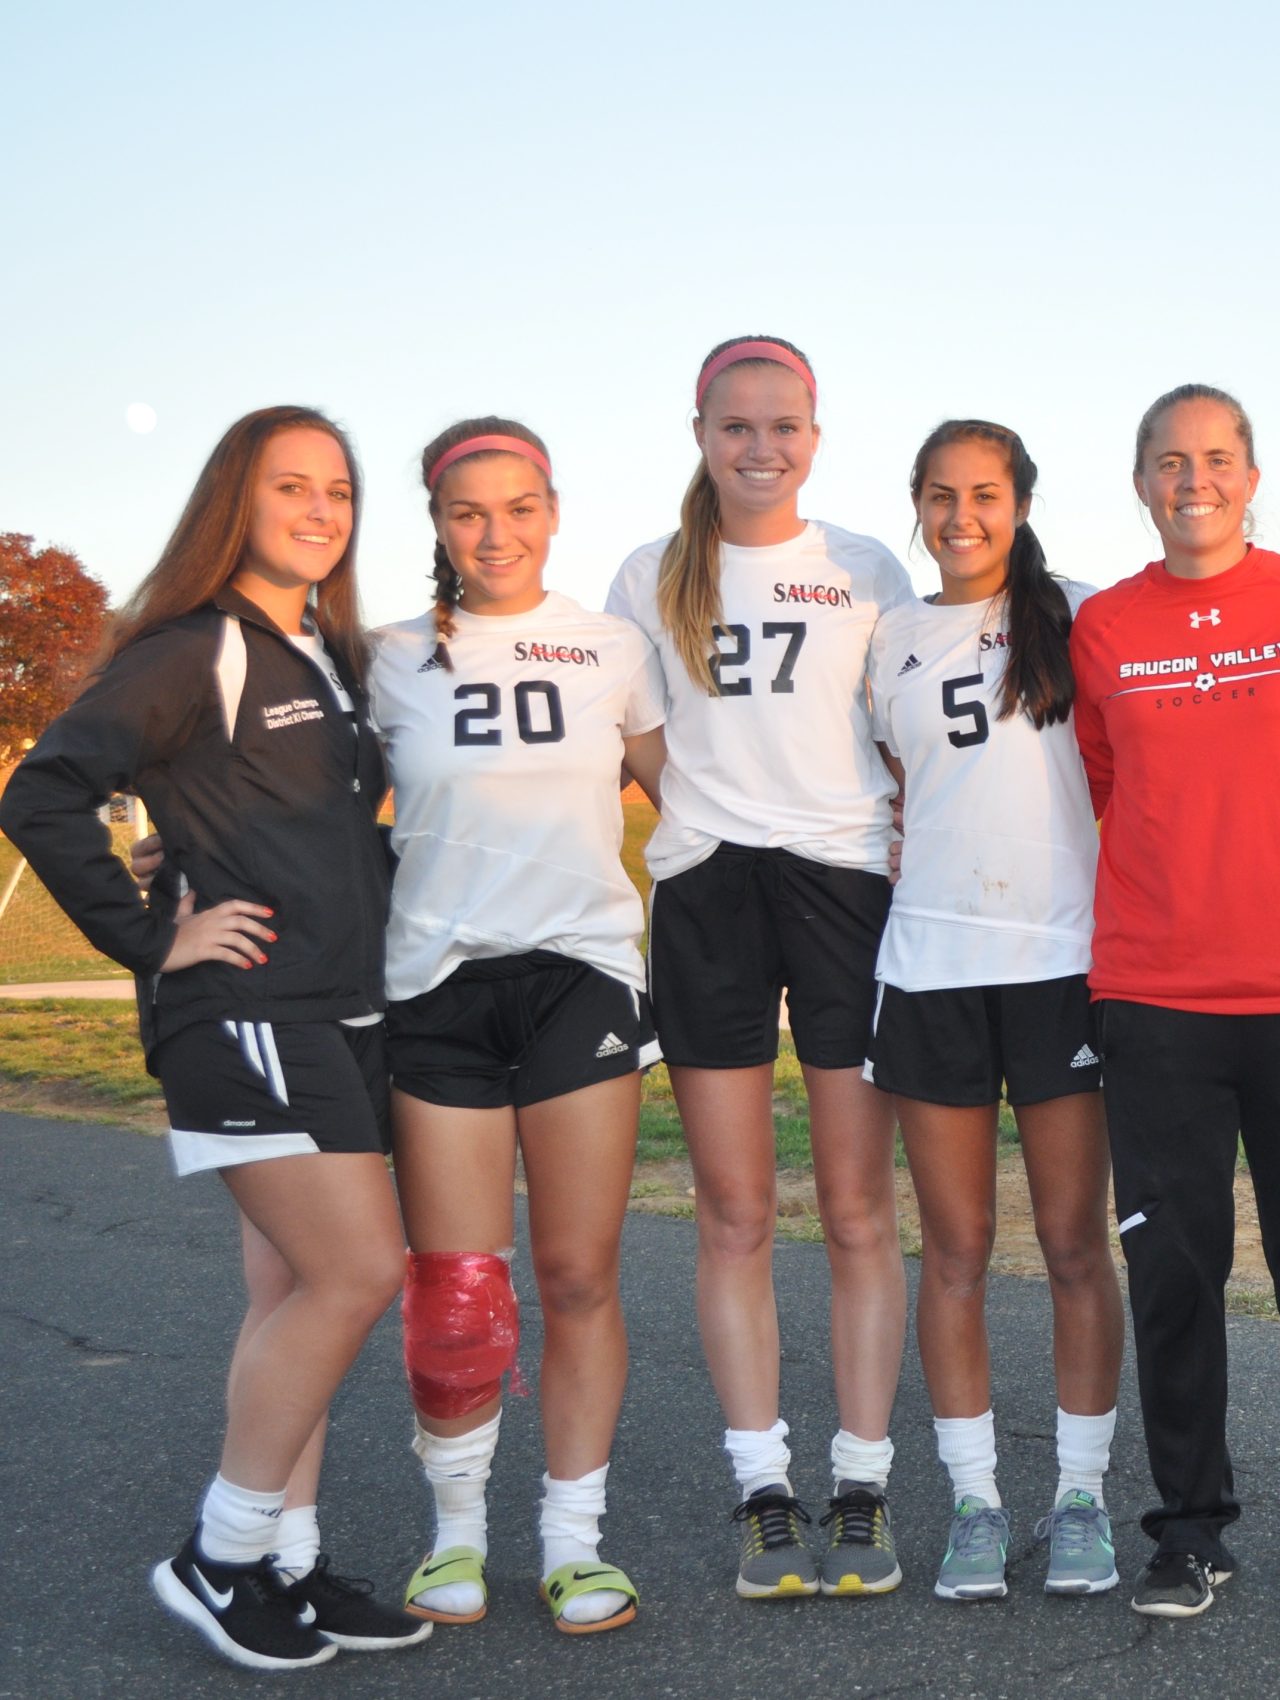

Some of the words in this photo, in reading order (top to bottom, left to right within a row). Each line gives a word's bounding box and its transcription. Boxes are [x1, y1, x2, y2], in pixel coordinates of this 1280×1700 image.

[773, 583, 852, 609] SAUCON
[514, 642, 600, 667] SAUCON
[708, 622, 807, 697] 27
[1119, 656, 1198, 679] SAUCON
[1156, 687, 1256, 709] SOCCER
[264, 703, 293, 717] League
[454, 680, 566, 747] 20
[942, 673, 989, 749] 5
[267, 715, 294, 730] District
[596, 1044, 629, 1058] adidas
[1070, 1056, 1099, 1068] adidas
